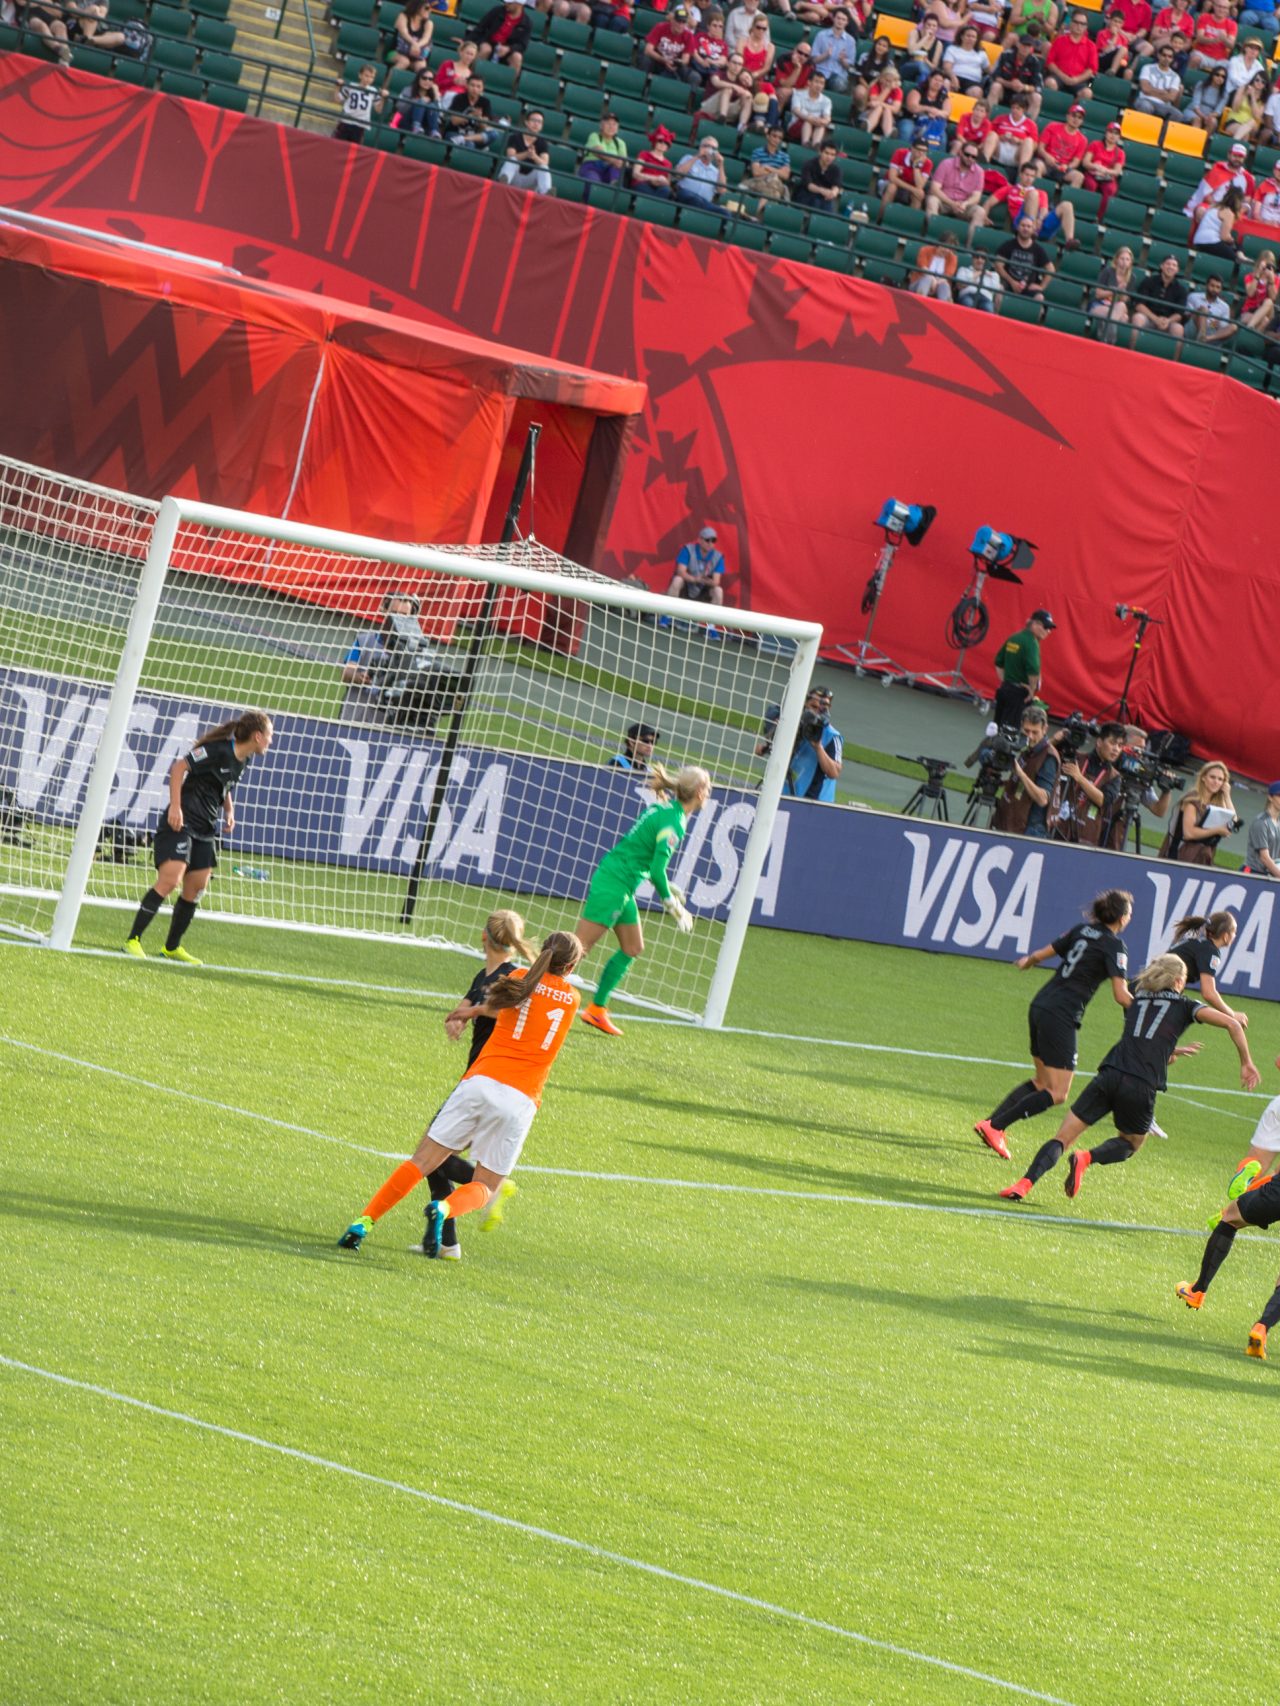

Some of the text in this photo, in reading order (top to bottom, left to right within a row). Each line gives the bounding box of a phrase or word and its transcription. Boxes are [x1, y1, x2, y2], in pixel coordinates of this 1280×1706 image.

[349, 92, 369, 111] 85
[14, 685, 200, 824] VISA
[338, 738, 508, 875] VISA
[634, 786, 790, 917] ISA
[903, 831, 1044, 954] VISA
[1062, 939, 1088, 979] 9
[534, 982, 574, 1005] ARTENS
[1133, 1000, 1171, 1039] 17
[512, 998, 565, 1051] 11
